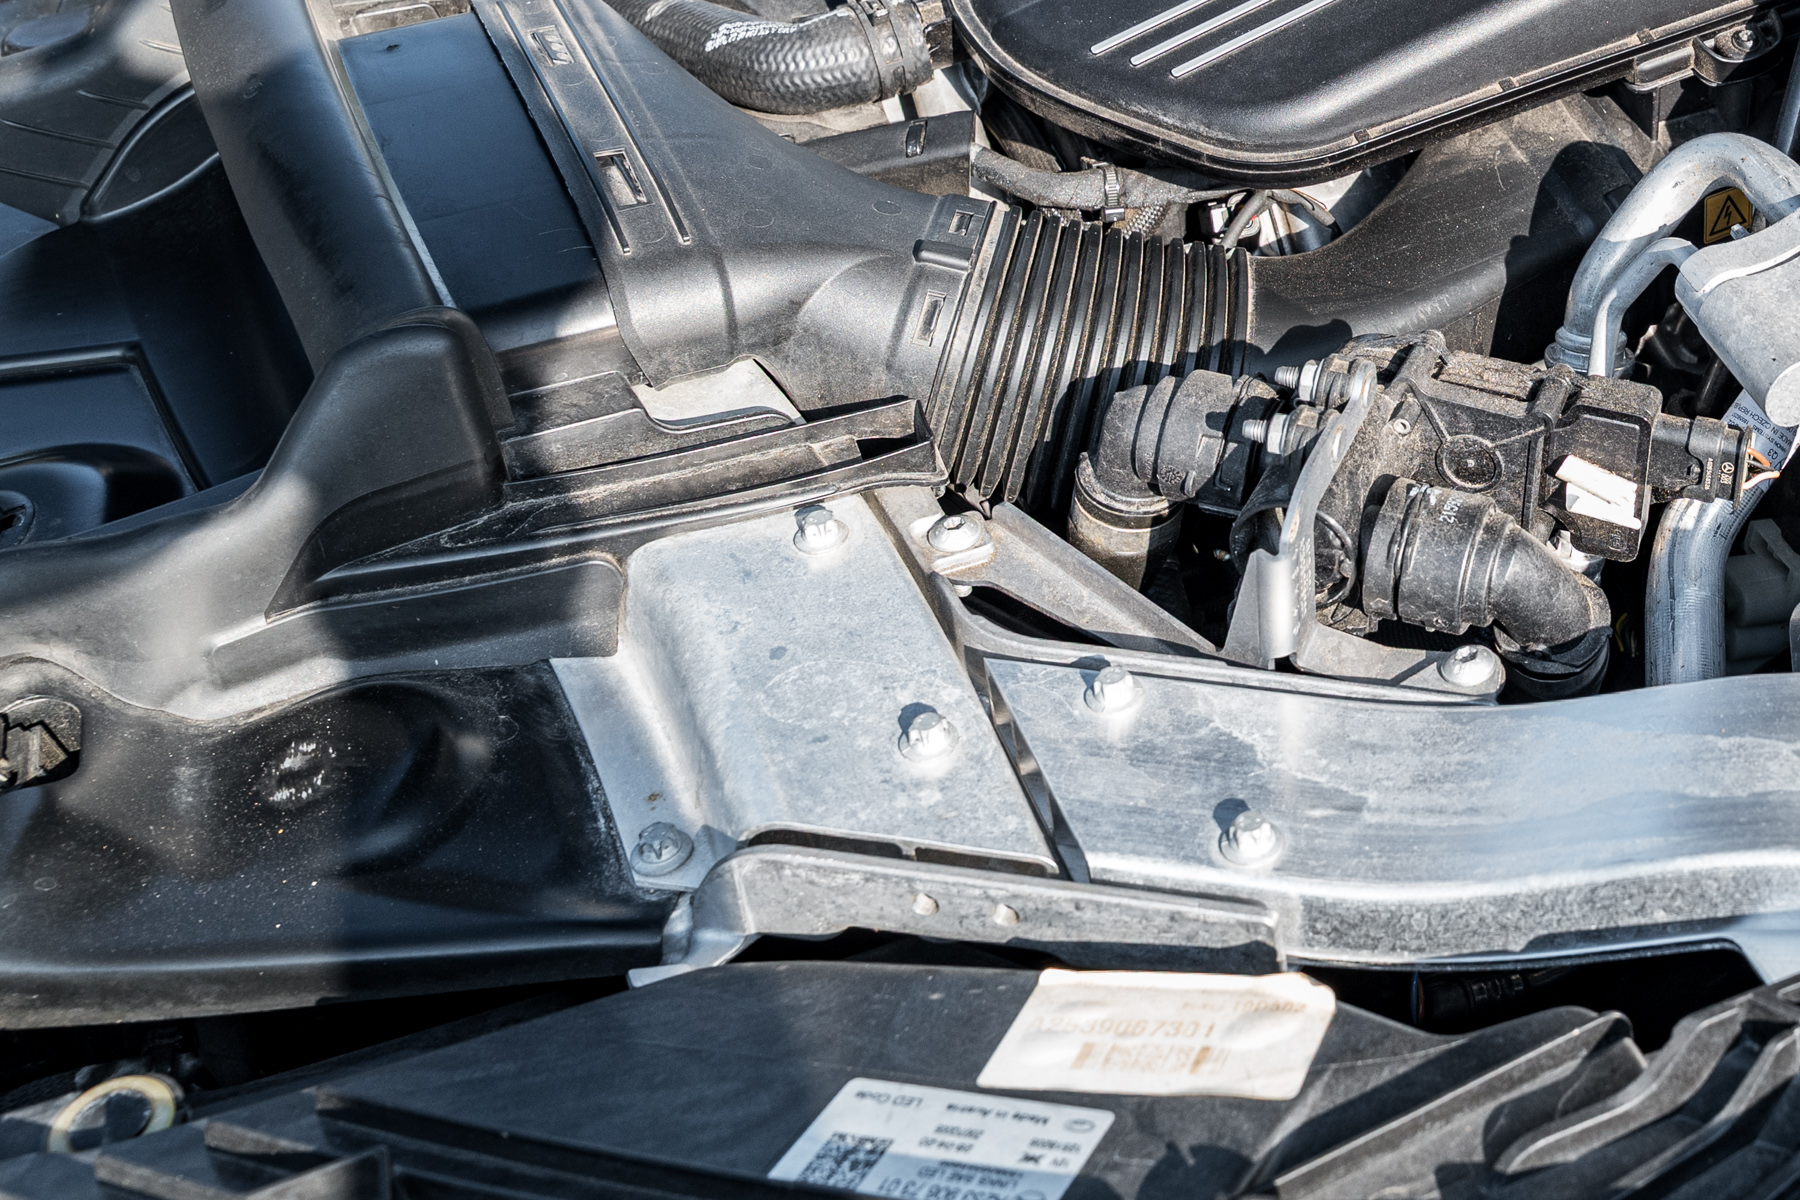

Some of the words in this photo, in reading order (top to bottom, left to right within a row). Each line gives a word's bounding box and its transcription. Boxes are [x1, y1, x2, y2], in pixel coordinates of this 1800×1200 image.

[1750, 411, 1772, 430] CZECH
[1770, 426, 1780, 436] IN
[855, 1089, 892, 1105] Code
[892, 1094, 924, 1108] LED
[946, 1102, 993, 1117] Austria
[994, 1108, 1009, 1119] in
[1011, 1111, 1050, 1126] Made
